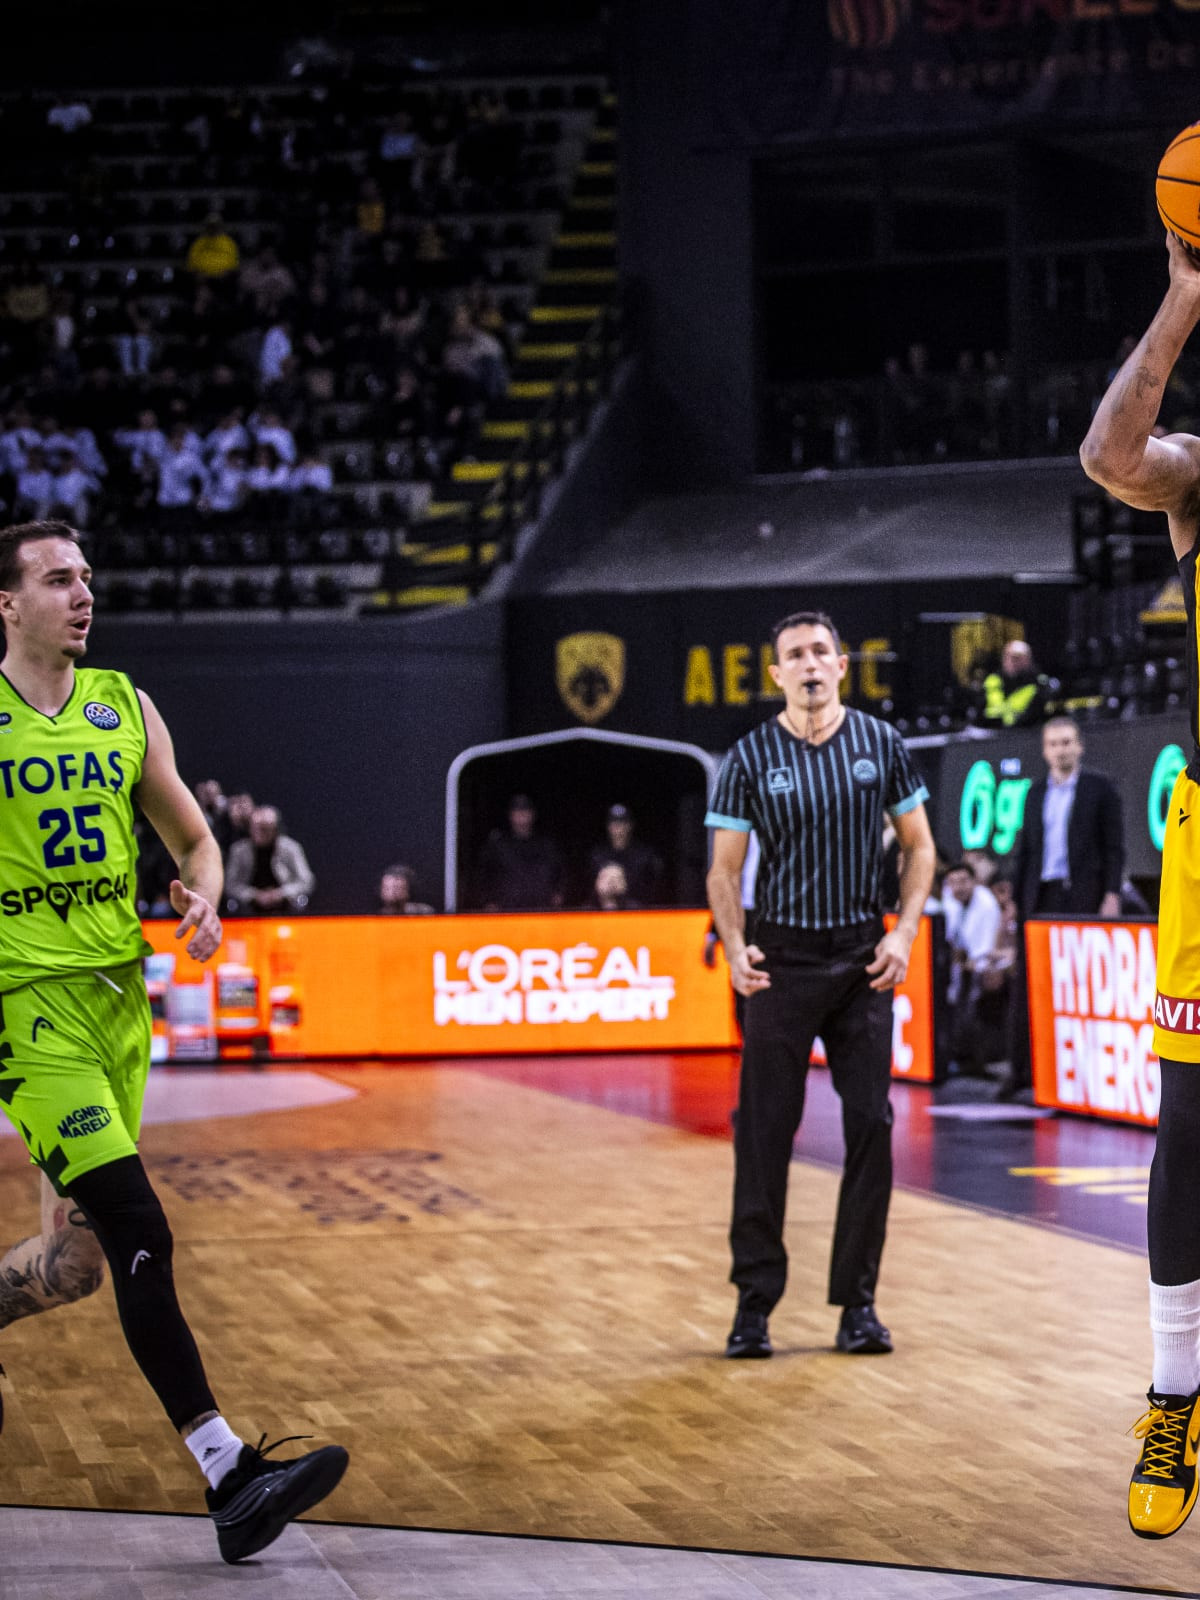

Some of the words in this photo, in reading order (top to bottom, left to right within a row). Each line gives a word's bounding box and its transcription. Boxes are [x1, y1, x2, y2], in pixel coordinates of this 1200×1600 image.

[0, 750, 125, 799] TOFAŞ
[38, 803, 107, 869] 25
[1049, 926, 1157, 1021] HYDRA
